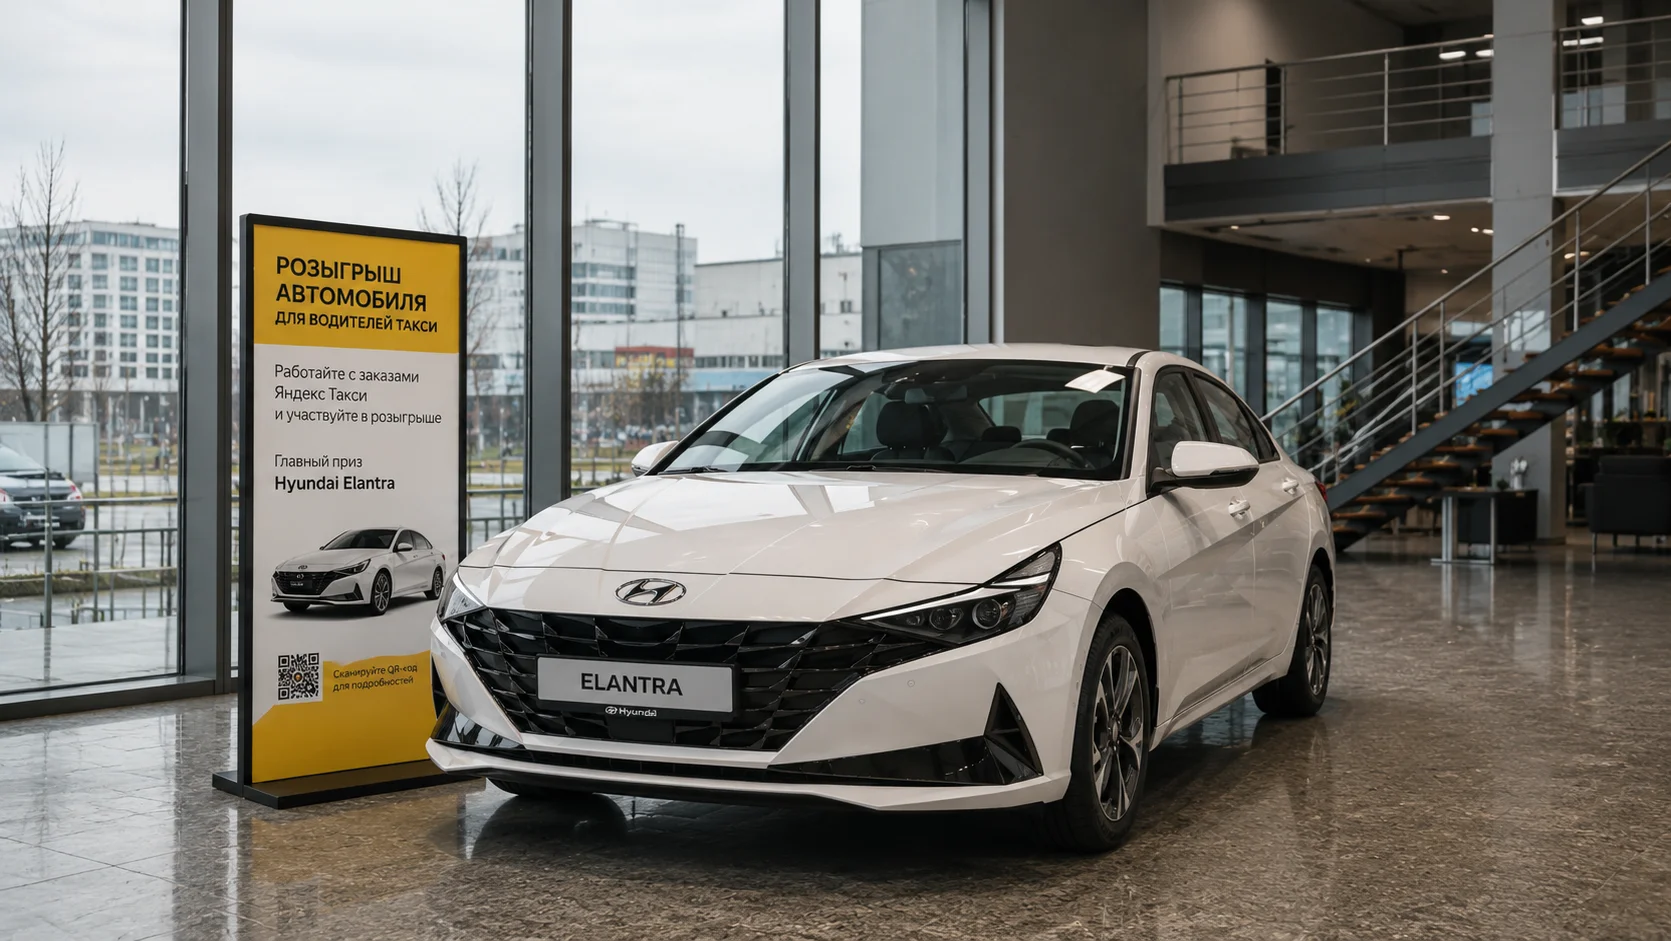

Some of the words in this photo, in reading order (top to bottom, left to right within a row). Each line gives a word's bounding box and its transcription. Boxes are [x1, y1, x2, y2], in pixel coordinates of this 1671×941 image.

[276, 256, 401, 284] РОЗЫГРЫШ
[276, 283, 427, 312] АВТОМОБИЛЯ
[275, 311, 305, 325] ДЛЯ
[309, 314, 393, 330] ВОДИТЕЛЕЙ
[396, 318, 438, 333] ТАКСИ
[275, 364, 345, 381] Работайте
[349, 371, 356, 381] с
[359, 370, 419, 383] заказами
[275, 386, 325, 402] Яндекс
[328, 388, 368, 402] Такси
[275, 410, 283, 420] и
[286, 409, 360, 424] участвуйте
[361, 413, 368, 423] в
[371, 413, 442, 425] розыгрыше
[275, 454, 329, 468] Главный
[333, 457, 363, 470] приз
[275, 476, 339, 493] Hyundai
[344, 476, 395, 490] Elantra
[333, 666, 386, 679] Сканируйте
[333, 682, 350, 692] для
[351, 676, 414, 690] подробностей
[581, 672, 683, 696] ELANTRA
